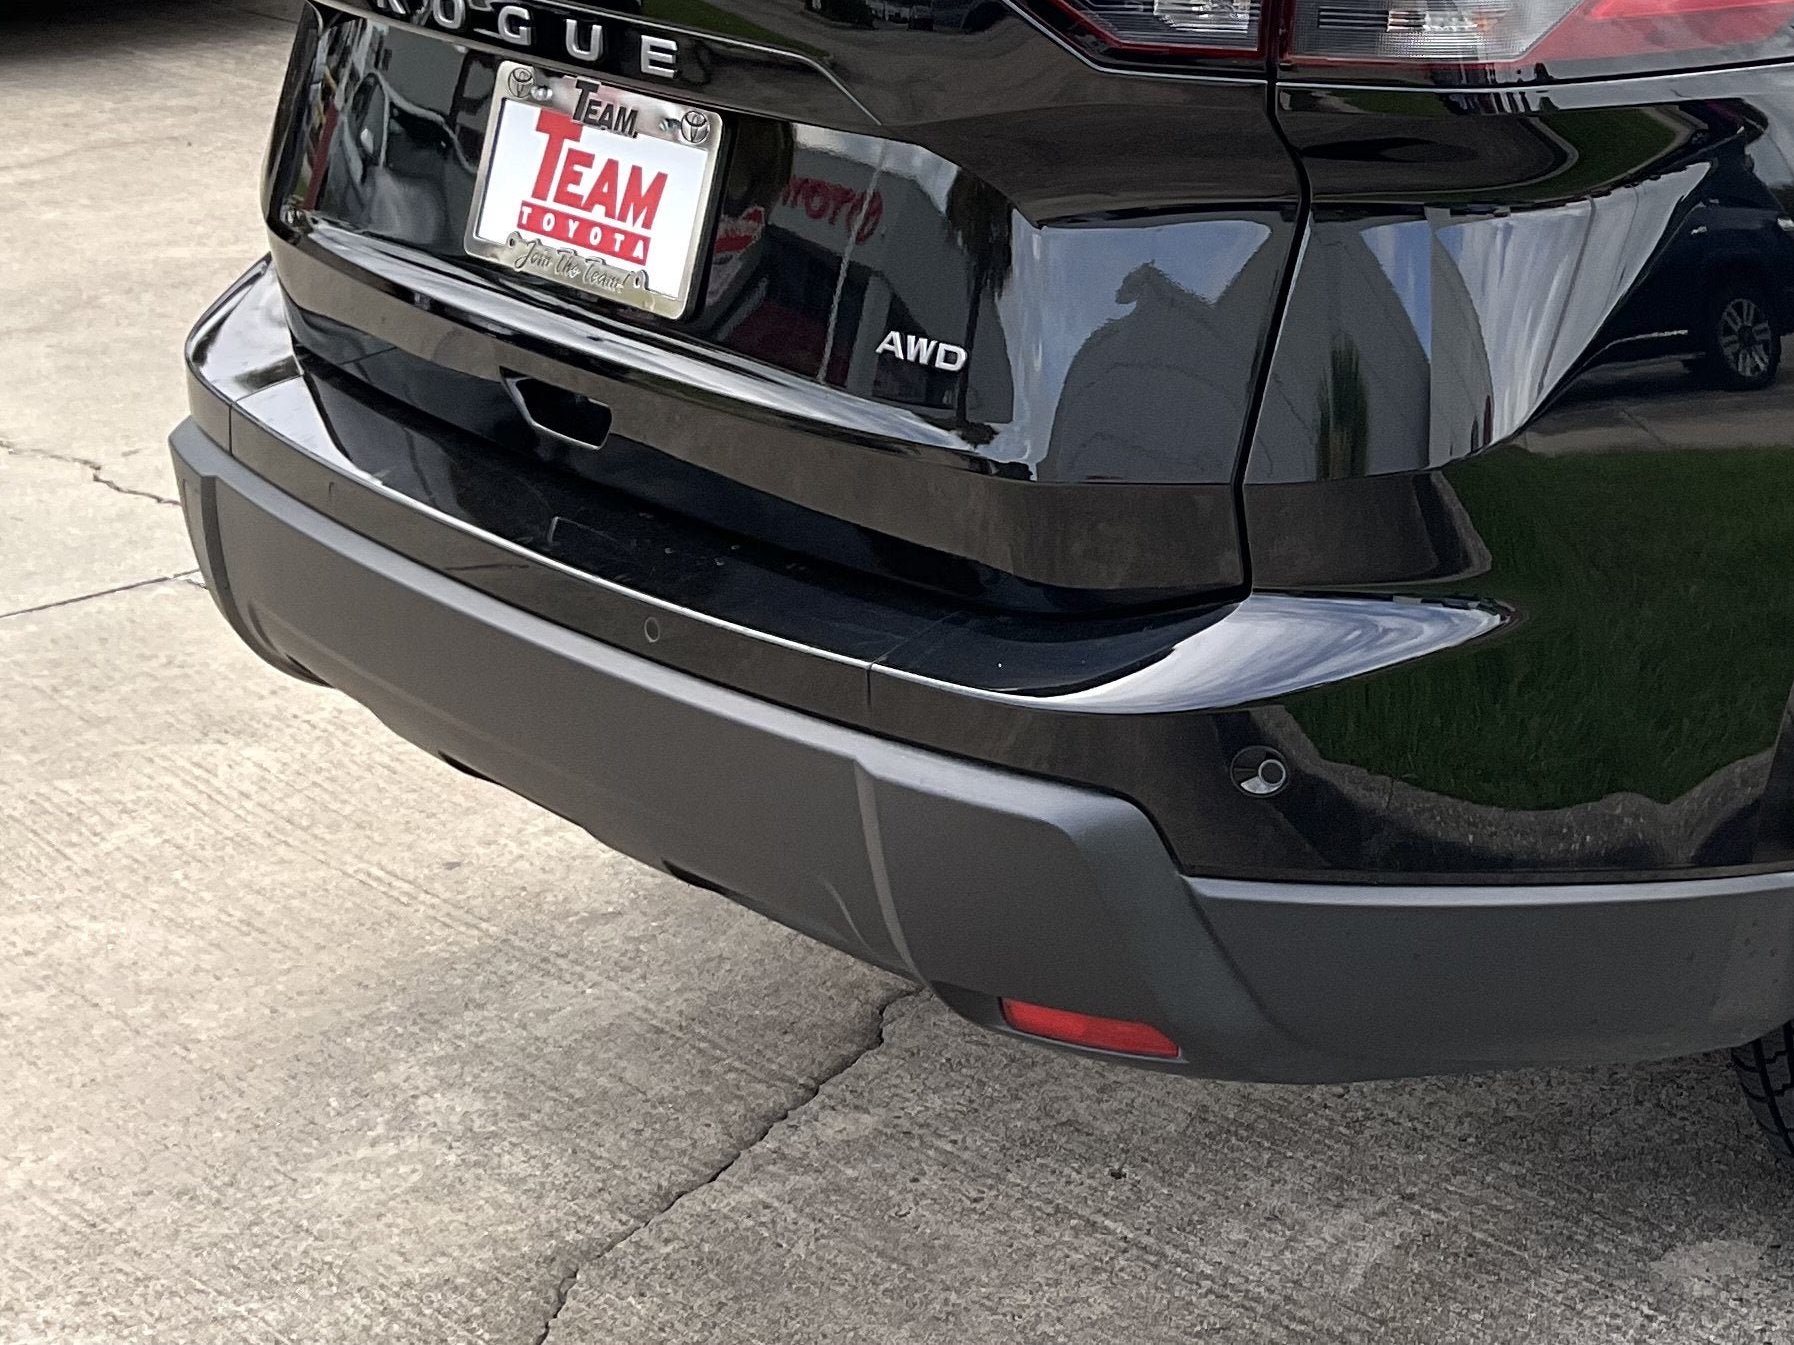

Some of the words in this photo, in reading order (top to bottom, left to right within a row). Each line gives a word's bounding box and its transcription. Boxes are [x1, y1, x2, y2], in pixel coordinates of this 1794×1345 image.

[531, 108, 669, 231] TEAM
[520, 205, 646, 260] TOYOTA
[514, 237, 552, 269] Join
[554, 248, 580, 278] The
[875, 330, 968, 372] AWD
